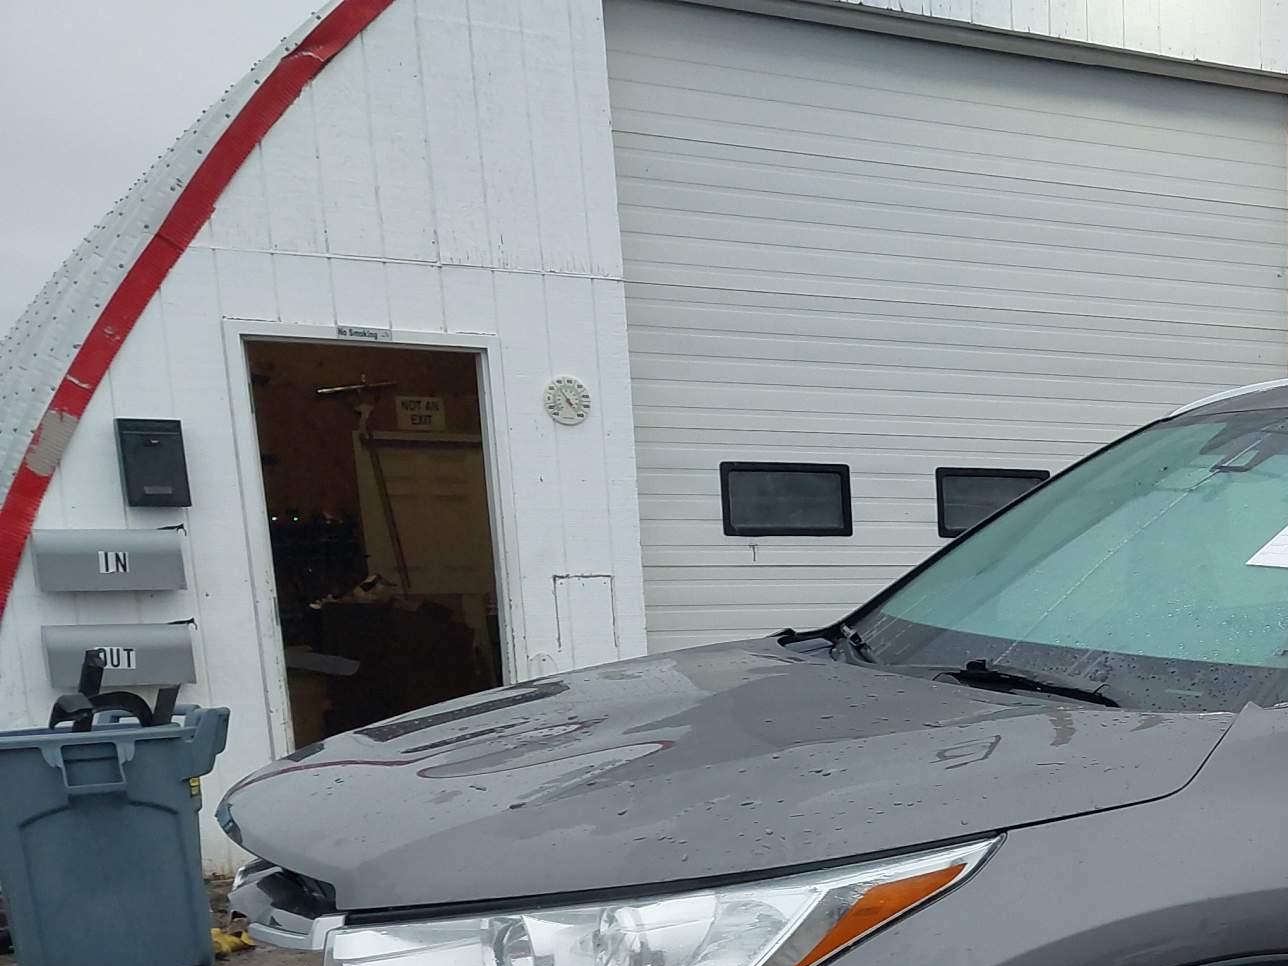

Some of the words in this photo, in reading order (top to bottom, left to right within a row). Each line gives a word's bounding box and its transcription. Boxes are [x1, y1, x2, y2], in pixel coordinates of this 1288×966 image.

[337, 327, 347, 336] No
[349, 328, 378, 340] Smoking
[401, 400, 421, 411] NOT
[425, 400, 440, 411] AN
[411, 414, 432, 425] EXIT
[104, 551, 128, 573] IN
